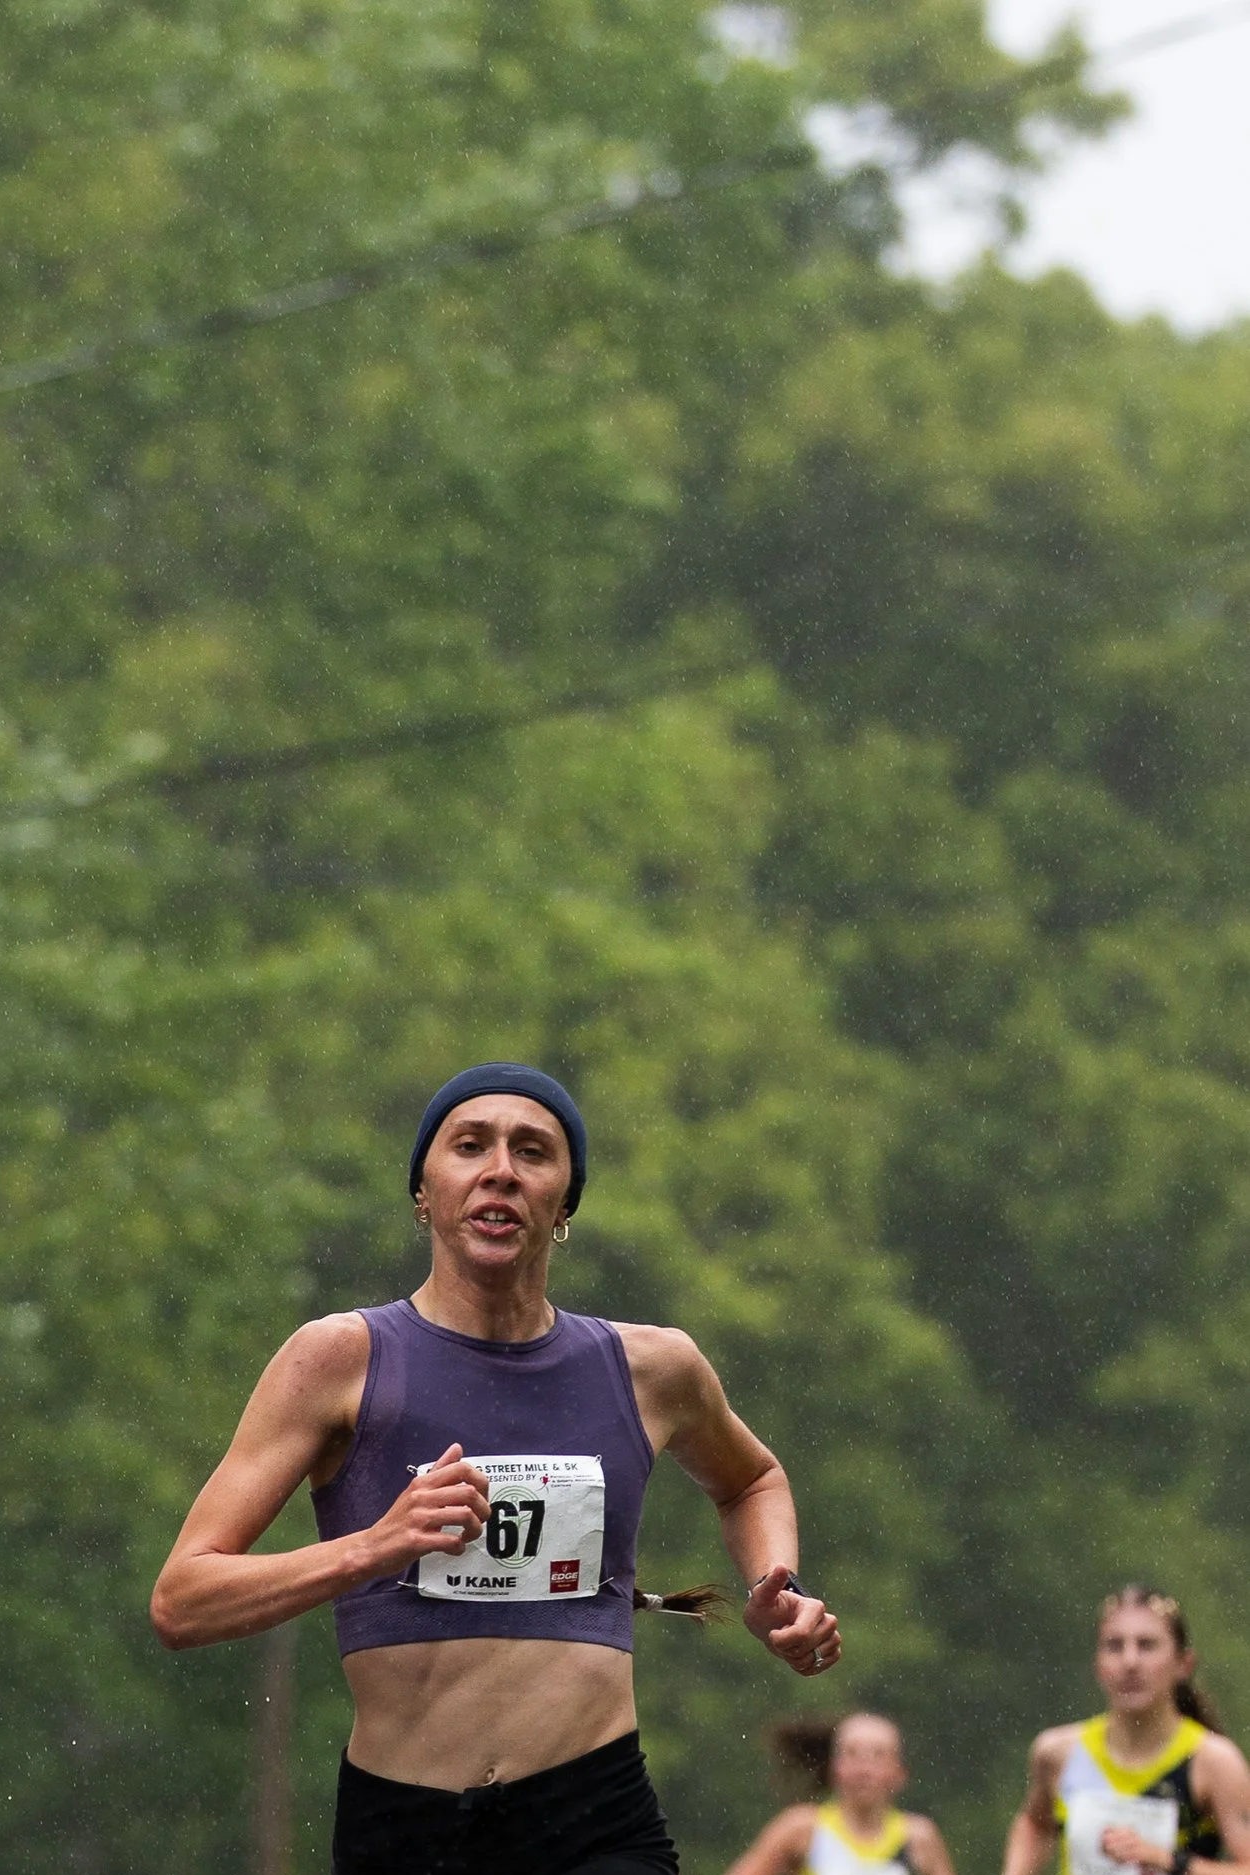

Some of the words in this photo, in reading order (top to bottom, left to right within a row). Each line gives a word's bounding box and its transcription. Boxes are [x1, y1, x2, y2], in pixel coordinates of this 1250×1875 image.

[485, 1464, 522, 1473] STREET
[524, 1463, 548, 1471] MILE
[552, 1463, 560, 1471] &
[564, 1463, 578, 1471] 5K
[486, 1474, 524, 1482] ESENTED
[486, 1500, 545, 1559] 67
[551, 1572, 579, 1580] EDGE
[465, 1576, 517, 1588] KANE
